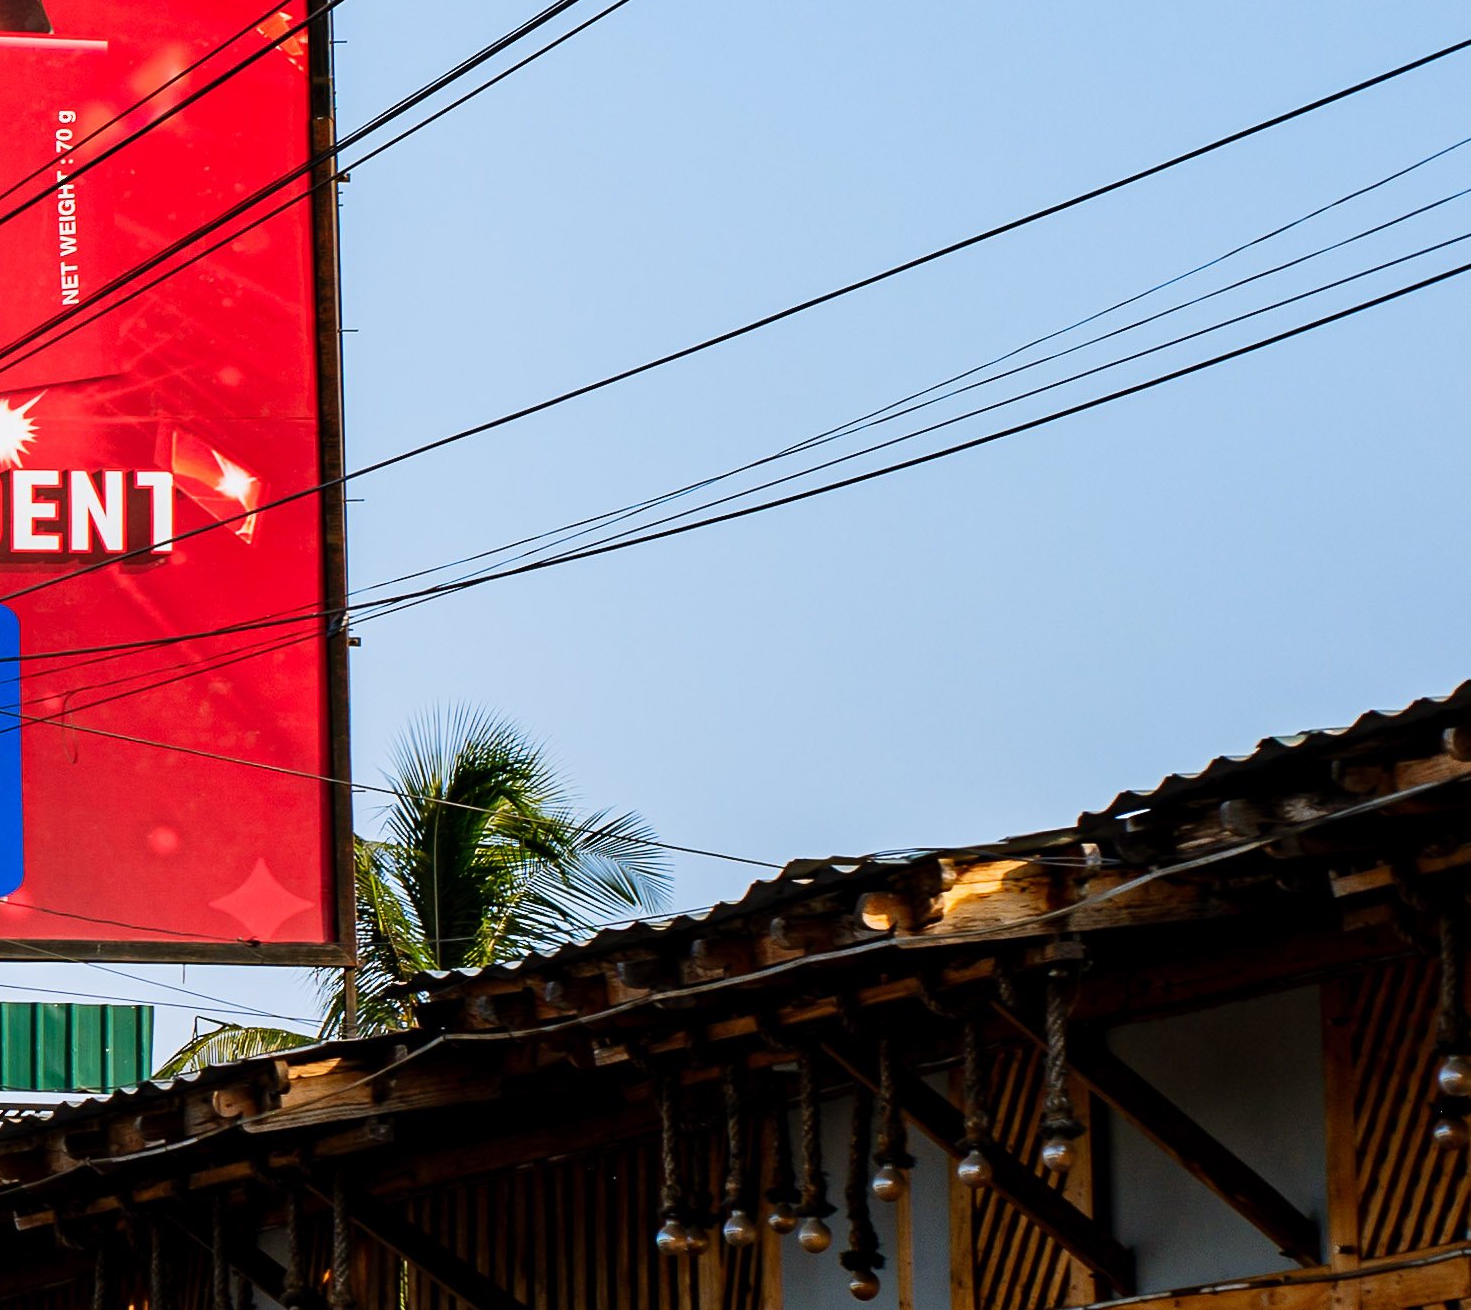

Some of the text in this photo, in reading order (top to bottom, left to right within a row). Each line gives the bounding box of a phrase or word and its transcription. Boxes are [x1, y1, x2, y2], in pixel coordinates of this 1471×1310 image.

[58, 110, 77, 123] g
[55, 128, 74, 154] 70
[56, 172, 79, 258] WEIGHT
[59, 261, 80, 306] NET
